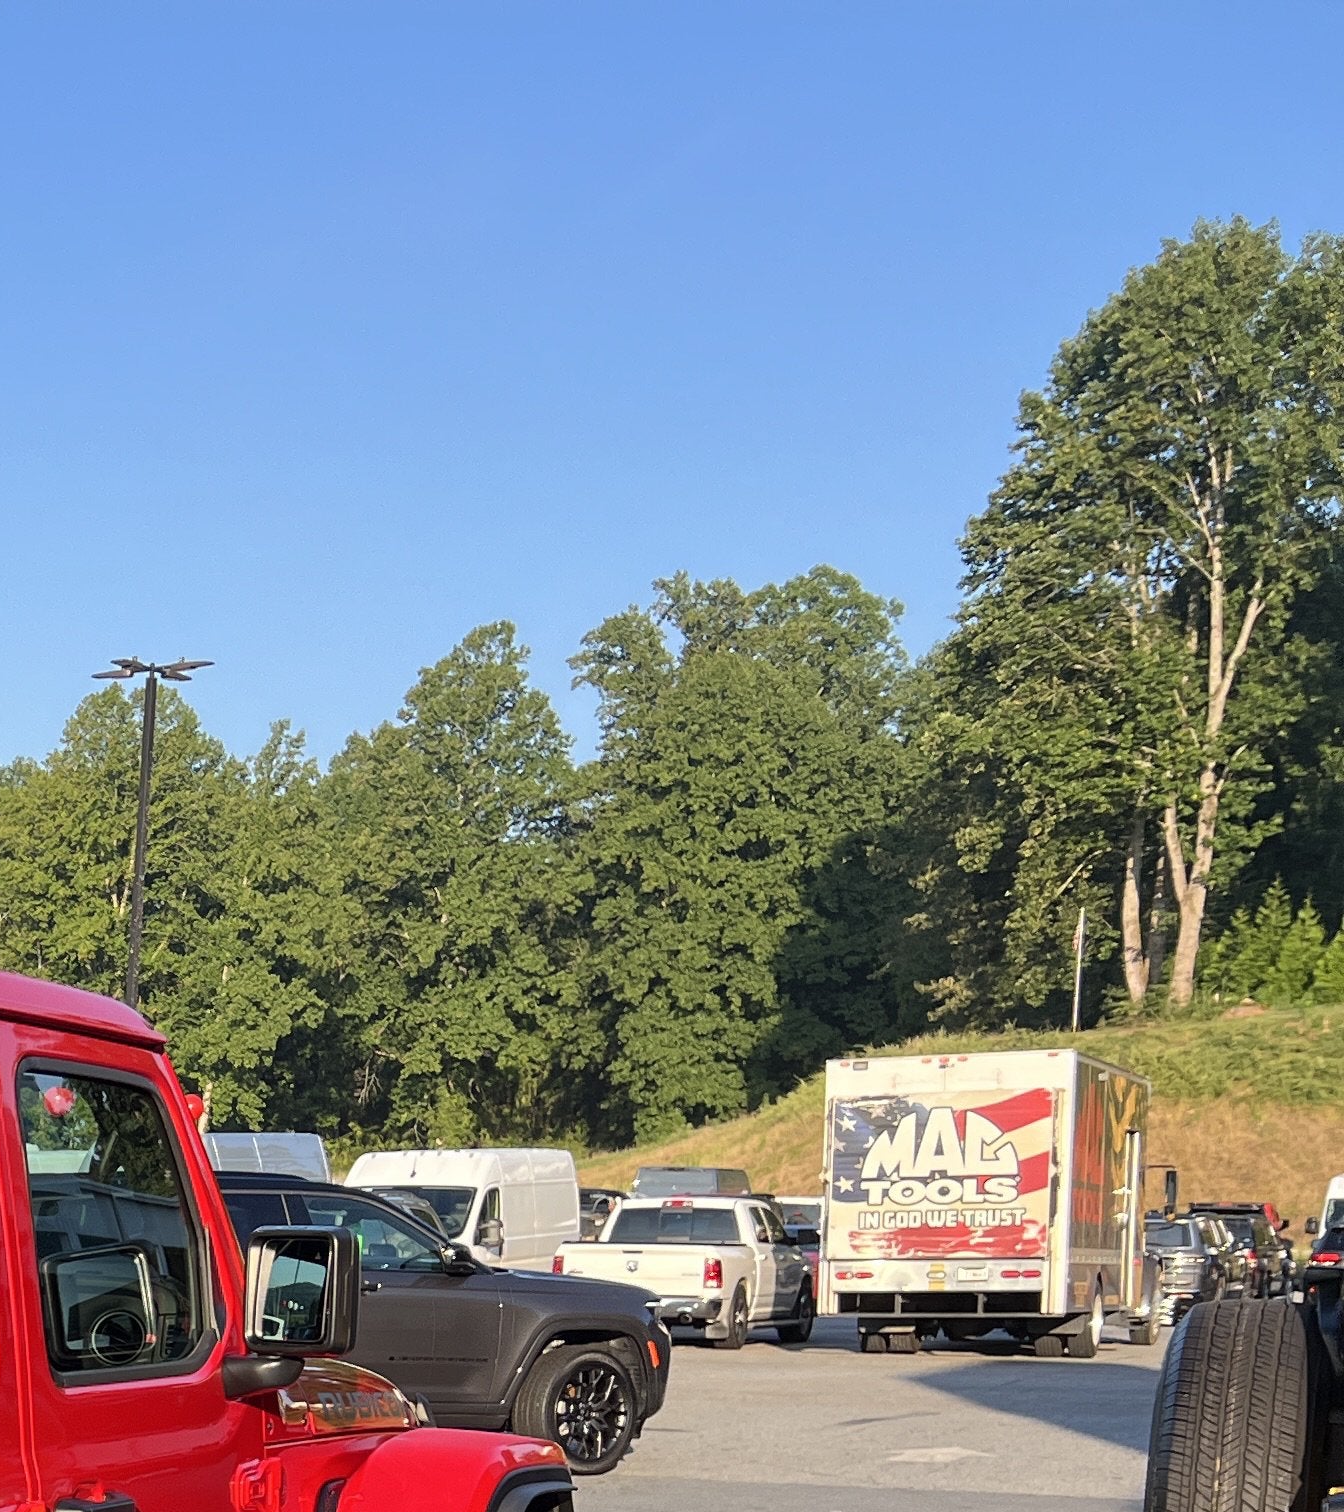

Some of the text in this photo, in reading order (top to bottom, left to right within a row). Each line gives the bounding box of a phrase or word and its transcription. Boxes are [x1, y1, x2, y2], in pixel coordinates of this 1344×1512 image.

[861, 1106, 1020, 1179] MAC
[860, 1177, 1020, 1206] TOOLS
[858, 1207, 1026, 1230] IN GOD WE TRUST
